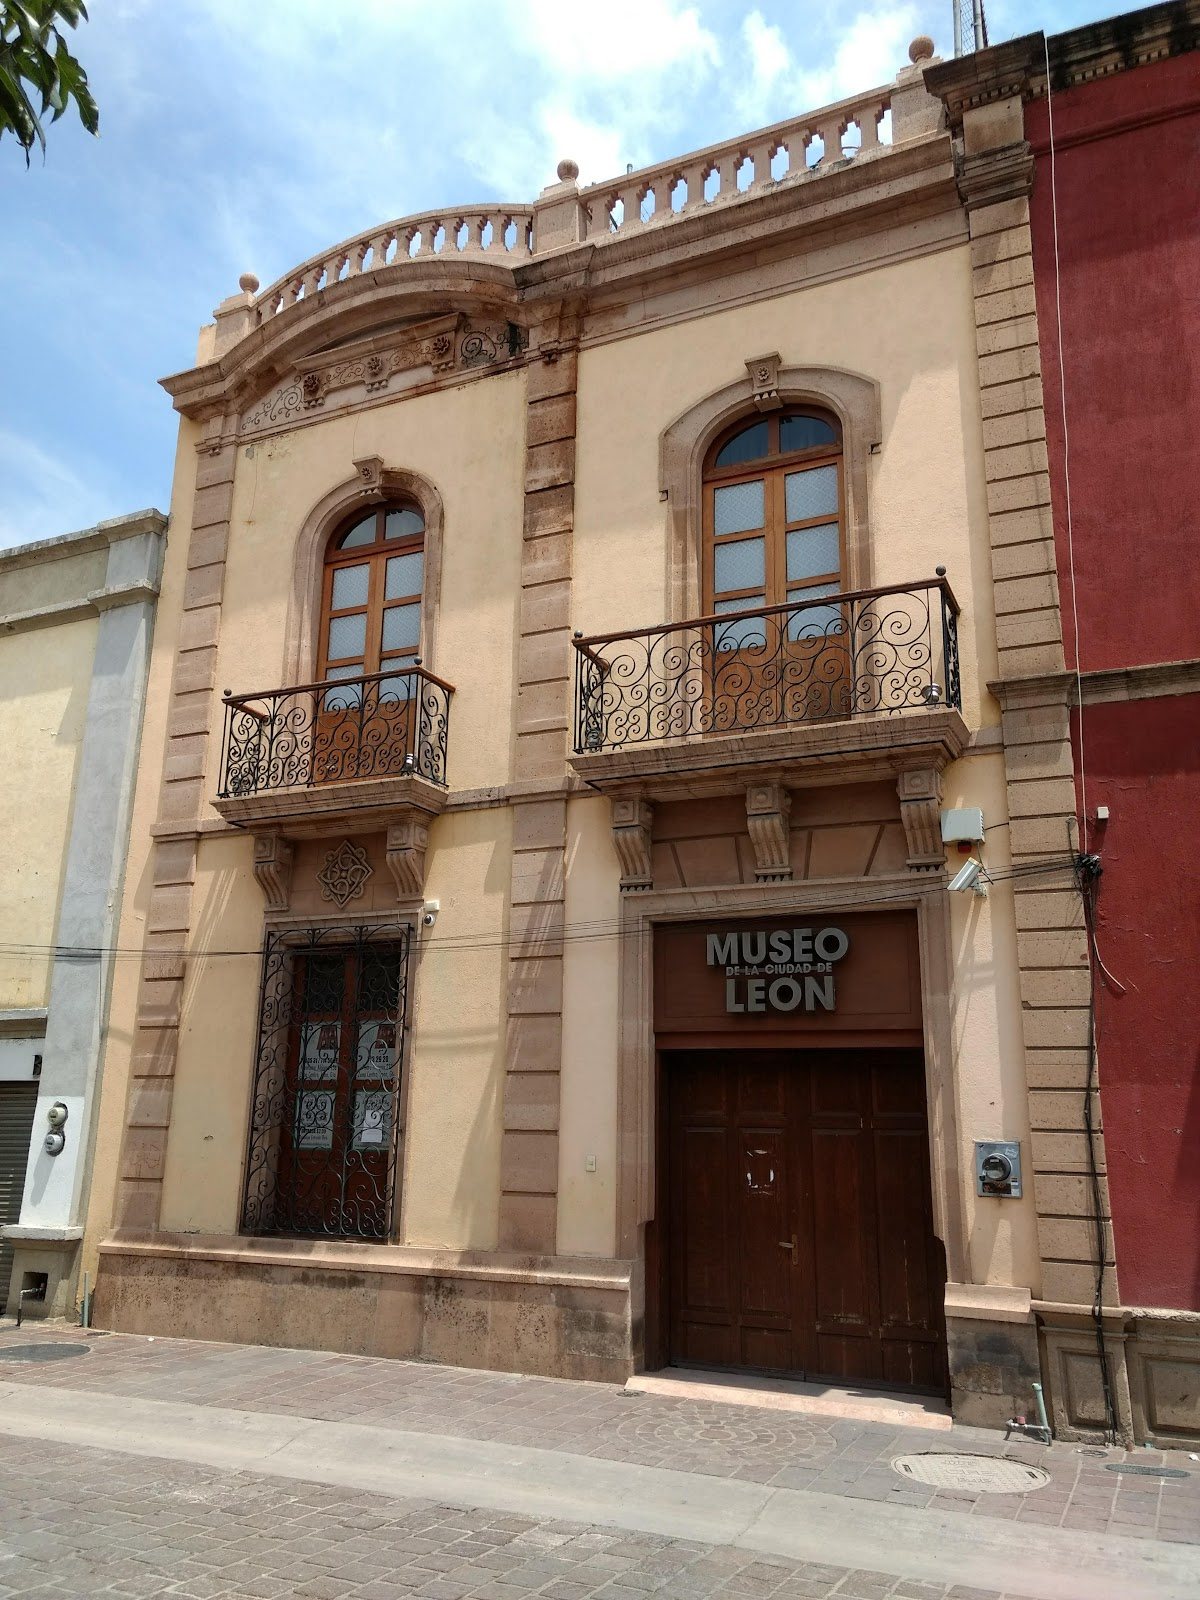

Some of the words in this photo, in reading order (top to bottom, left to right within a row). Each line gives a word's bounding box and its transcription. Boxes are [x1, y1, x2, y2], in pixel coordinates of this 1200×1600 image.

[706, 927, 849, 966] MUSEO
[726, 966, 740, 977] DE
[745, 965, 760, 976] LA
[764, 963, 812, 975] CIUDAD
[817, 962, 833, 973] DE
